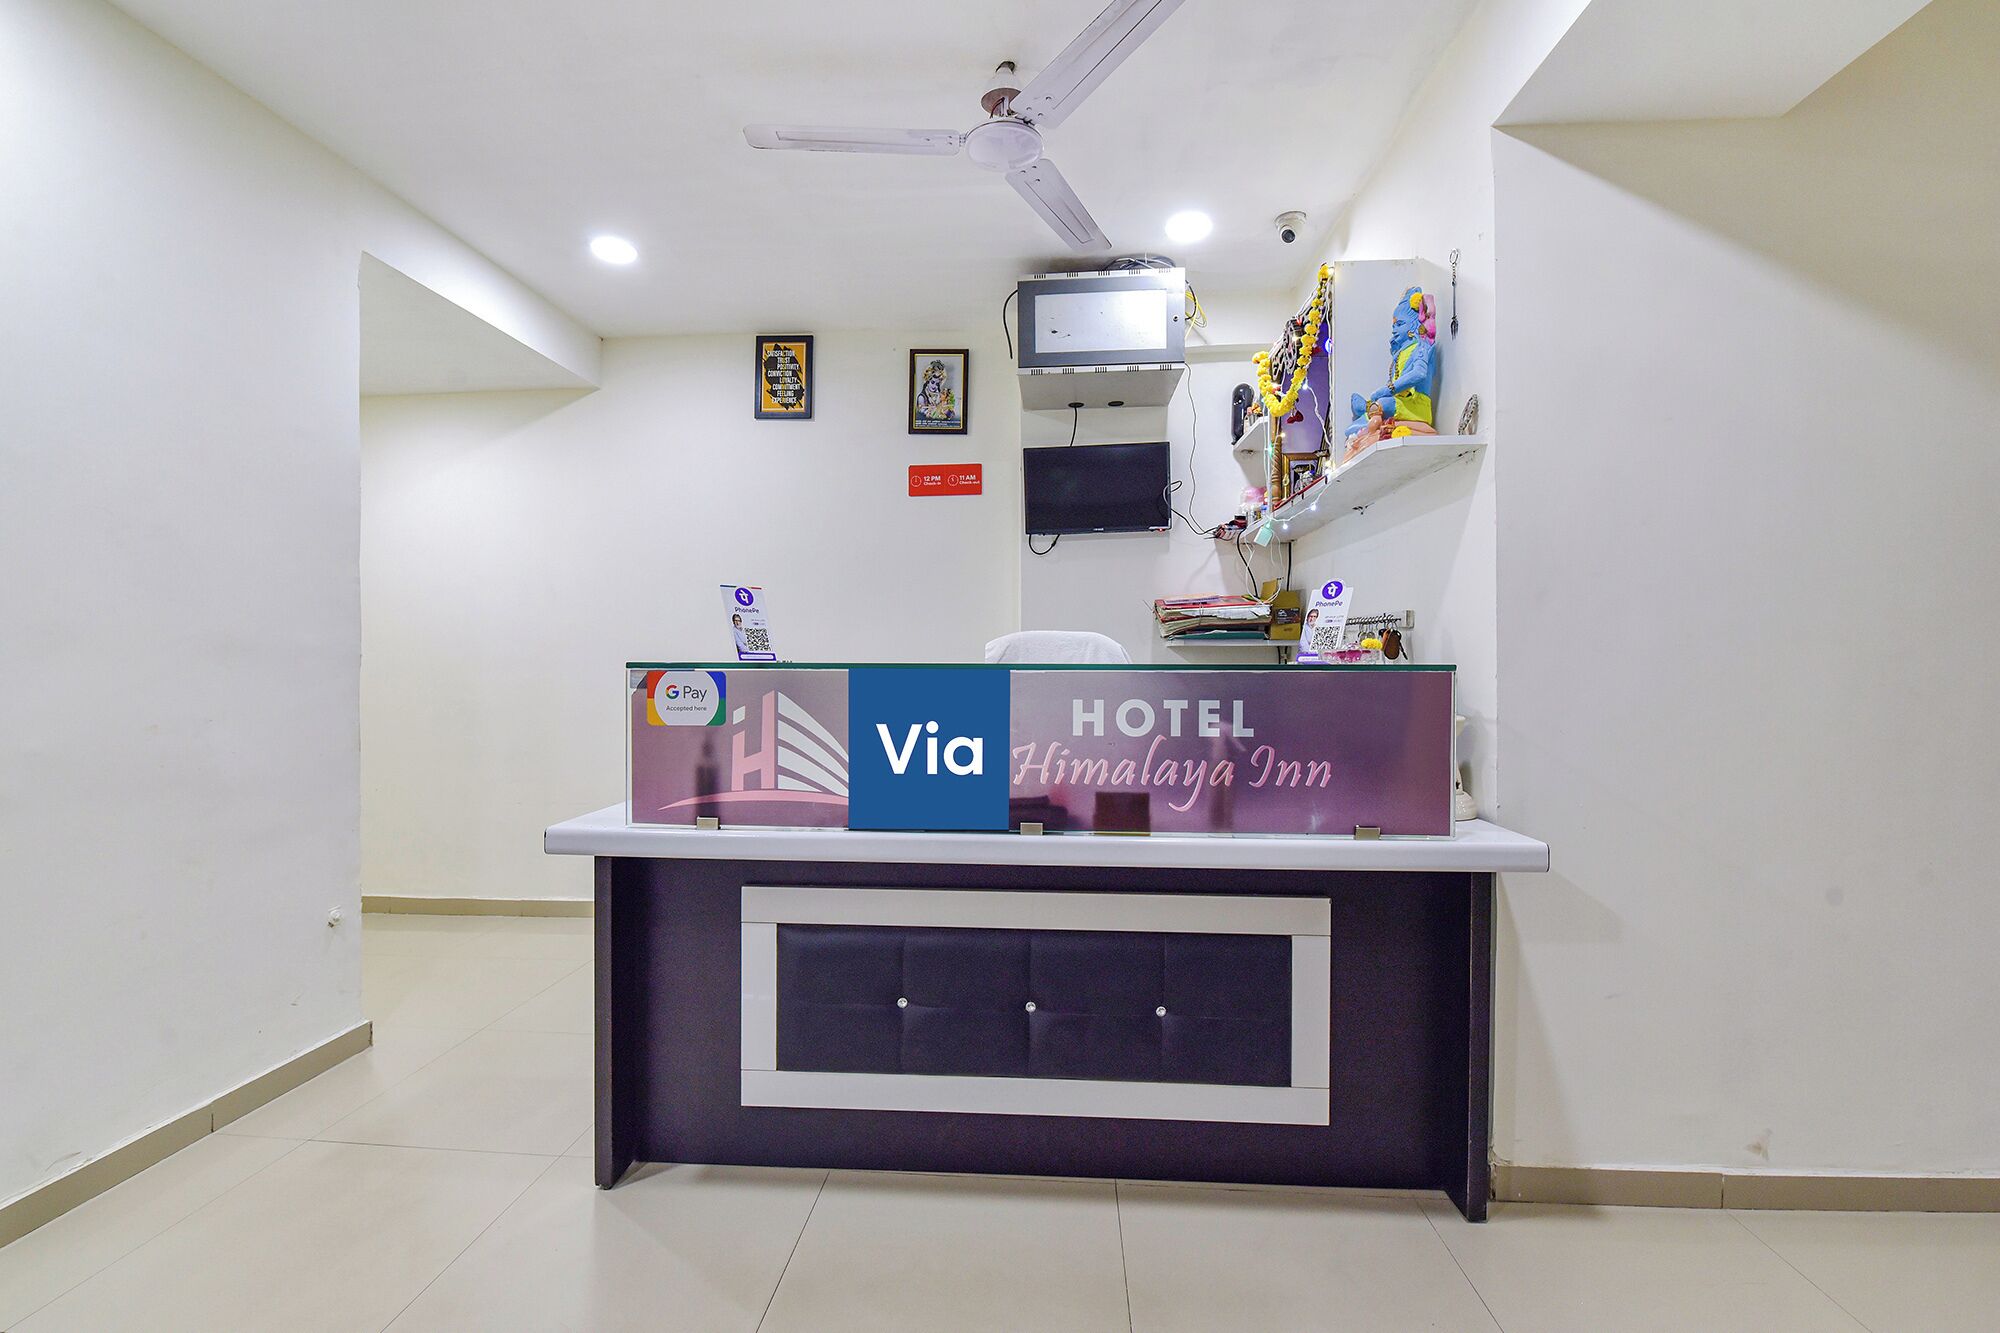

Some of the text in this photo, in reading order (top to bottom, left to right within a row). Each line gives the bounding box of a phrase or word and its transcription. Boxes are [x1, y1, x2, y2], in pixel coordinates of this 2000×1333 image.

[665, 684, 707, 702] G Pay
[1072, 699, 1255, 738] HOTEL
[875, 720, 984, 776] Via
[1012, 734, 1332, 812] Himalaya Inn
